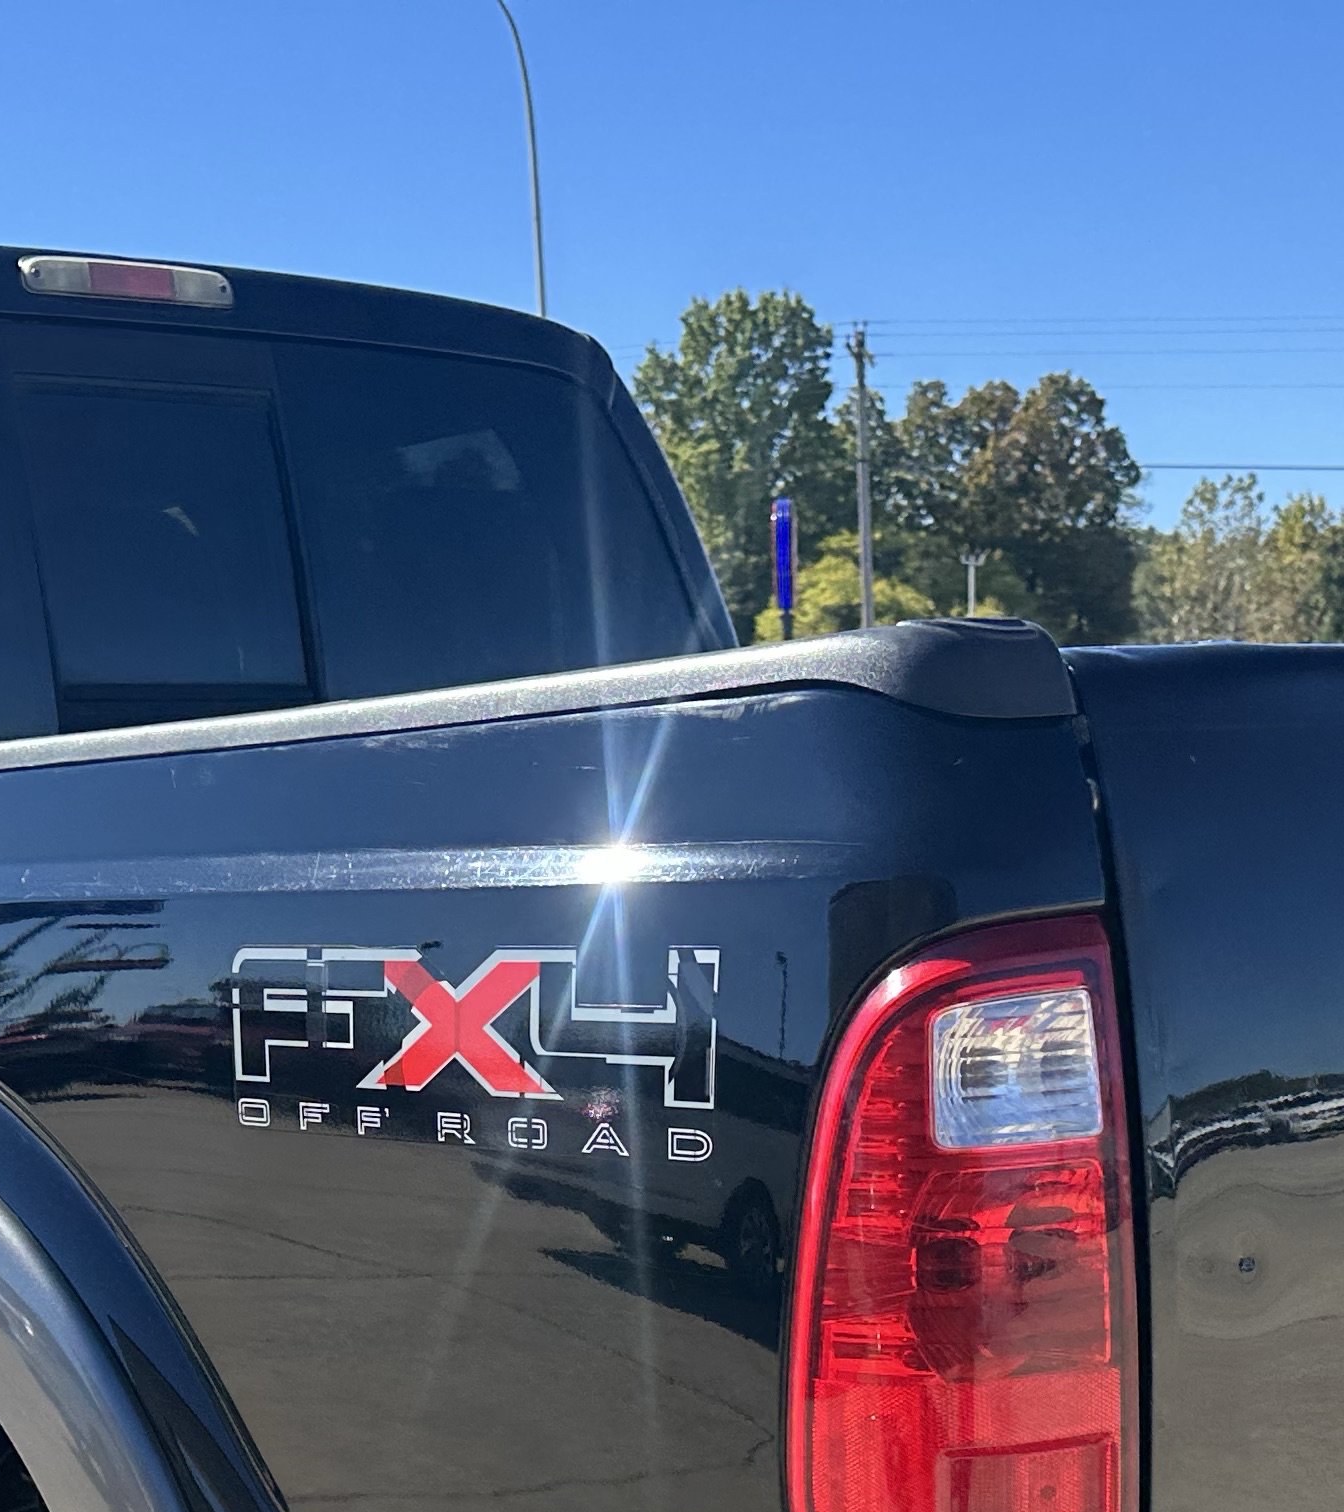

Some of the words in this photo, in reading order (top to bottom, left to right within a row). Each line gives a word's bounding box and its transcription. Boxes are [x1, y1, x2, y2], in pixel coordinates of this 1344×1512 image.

[232, 944, 720, 1110] FX4
[238, 1096, 390, 1135] OFF
[436, 1111, 714, 1163] ROAD
